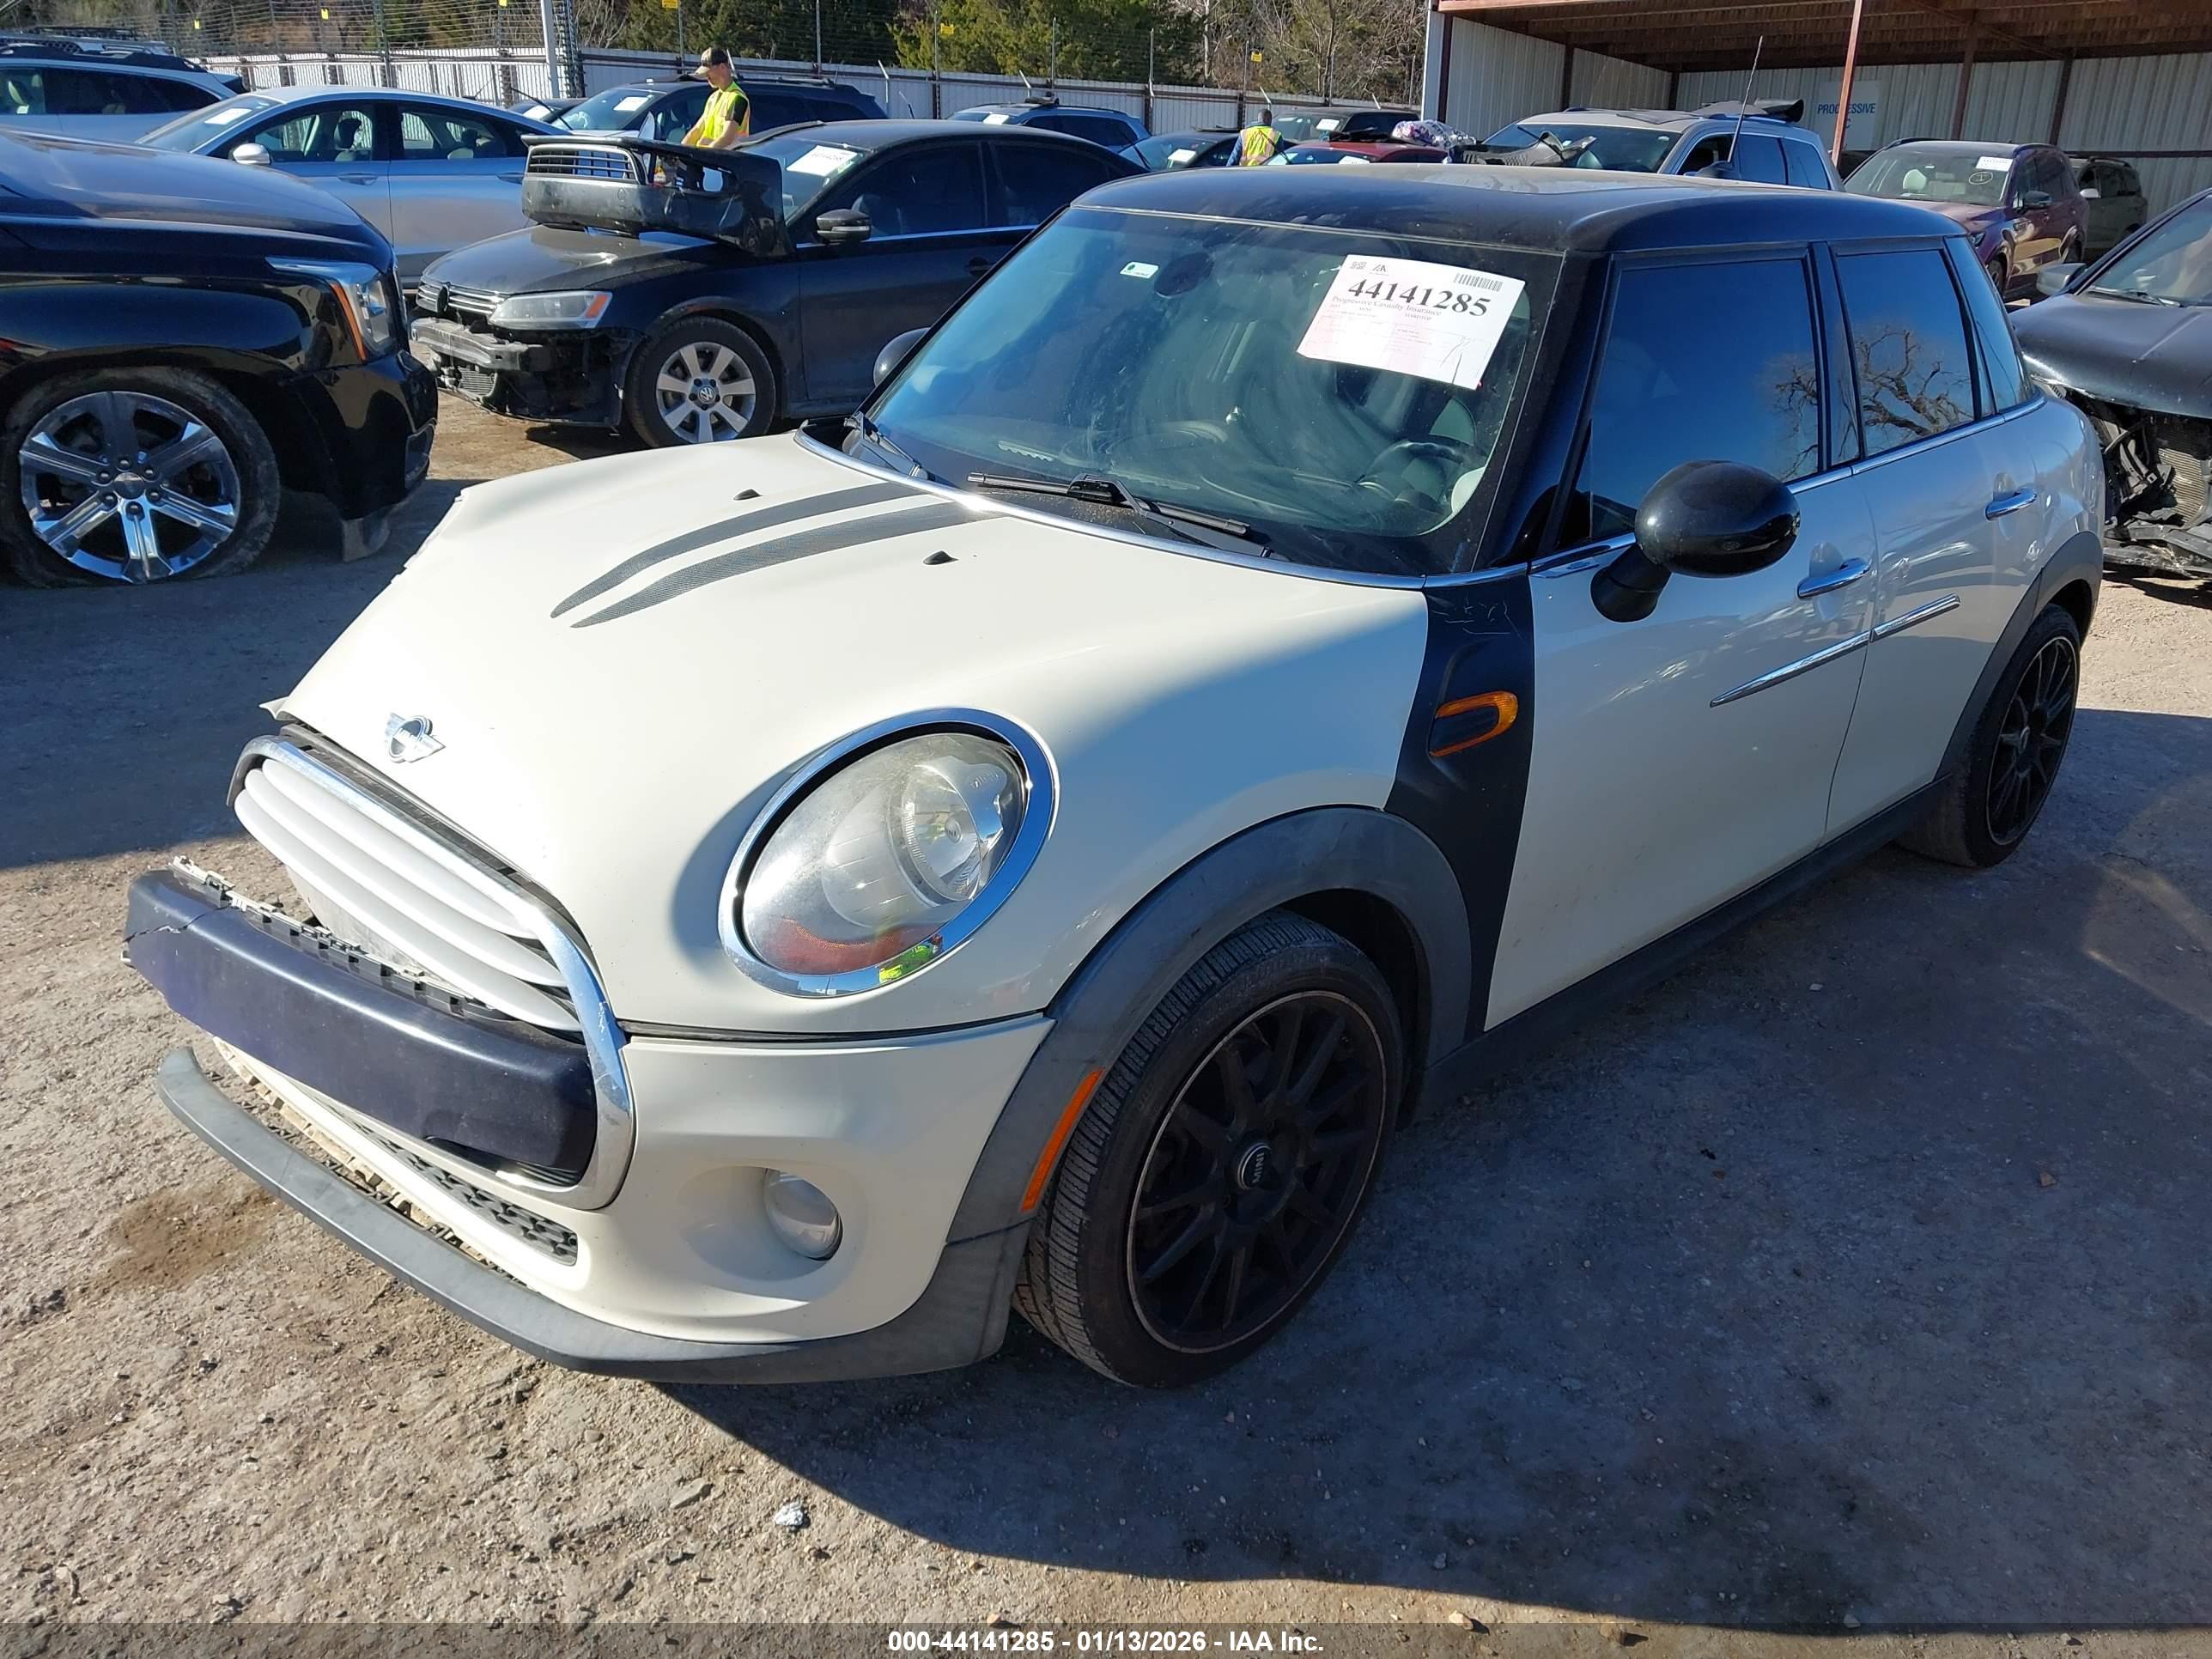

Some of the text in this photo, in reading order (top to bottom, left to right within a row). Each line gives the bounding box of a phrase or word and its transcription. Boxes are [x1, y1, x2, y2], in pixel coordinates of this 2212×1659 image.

[1817, 102, 1876, 114] PROGESSIVE
[1332, 295, 1372, 307] Progressive
[1373, 300, 1405, 310] Casualty
[1406, 304, 1443, 317] Insurance
[1348, 278, 1492, 317] 44141285
[1251, 1152, 1265, 1184] MINI
